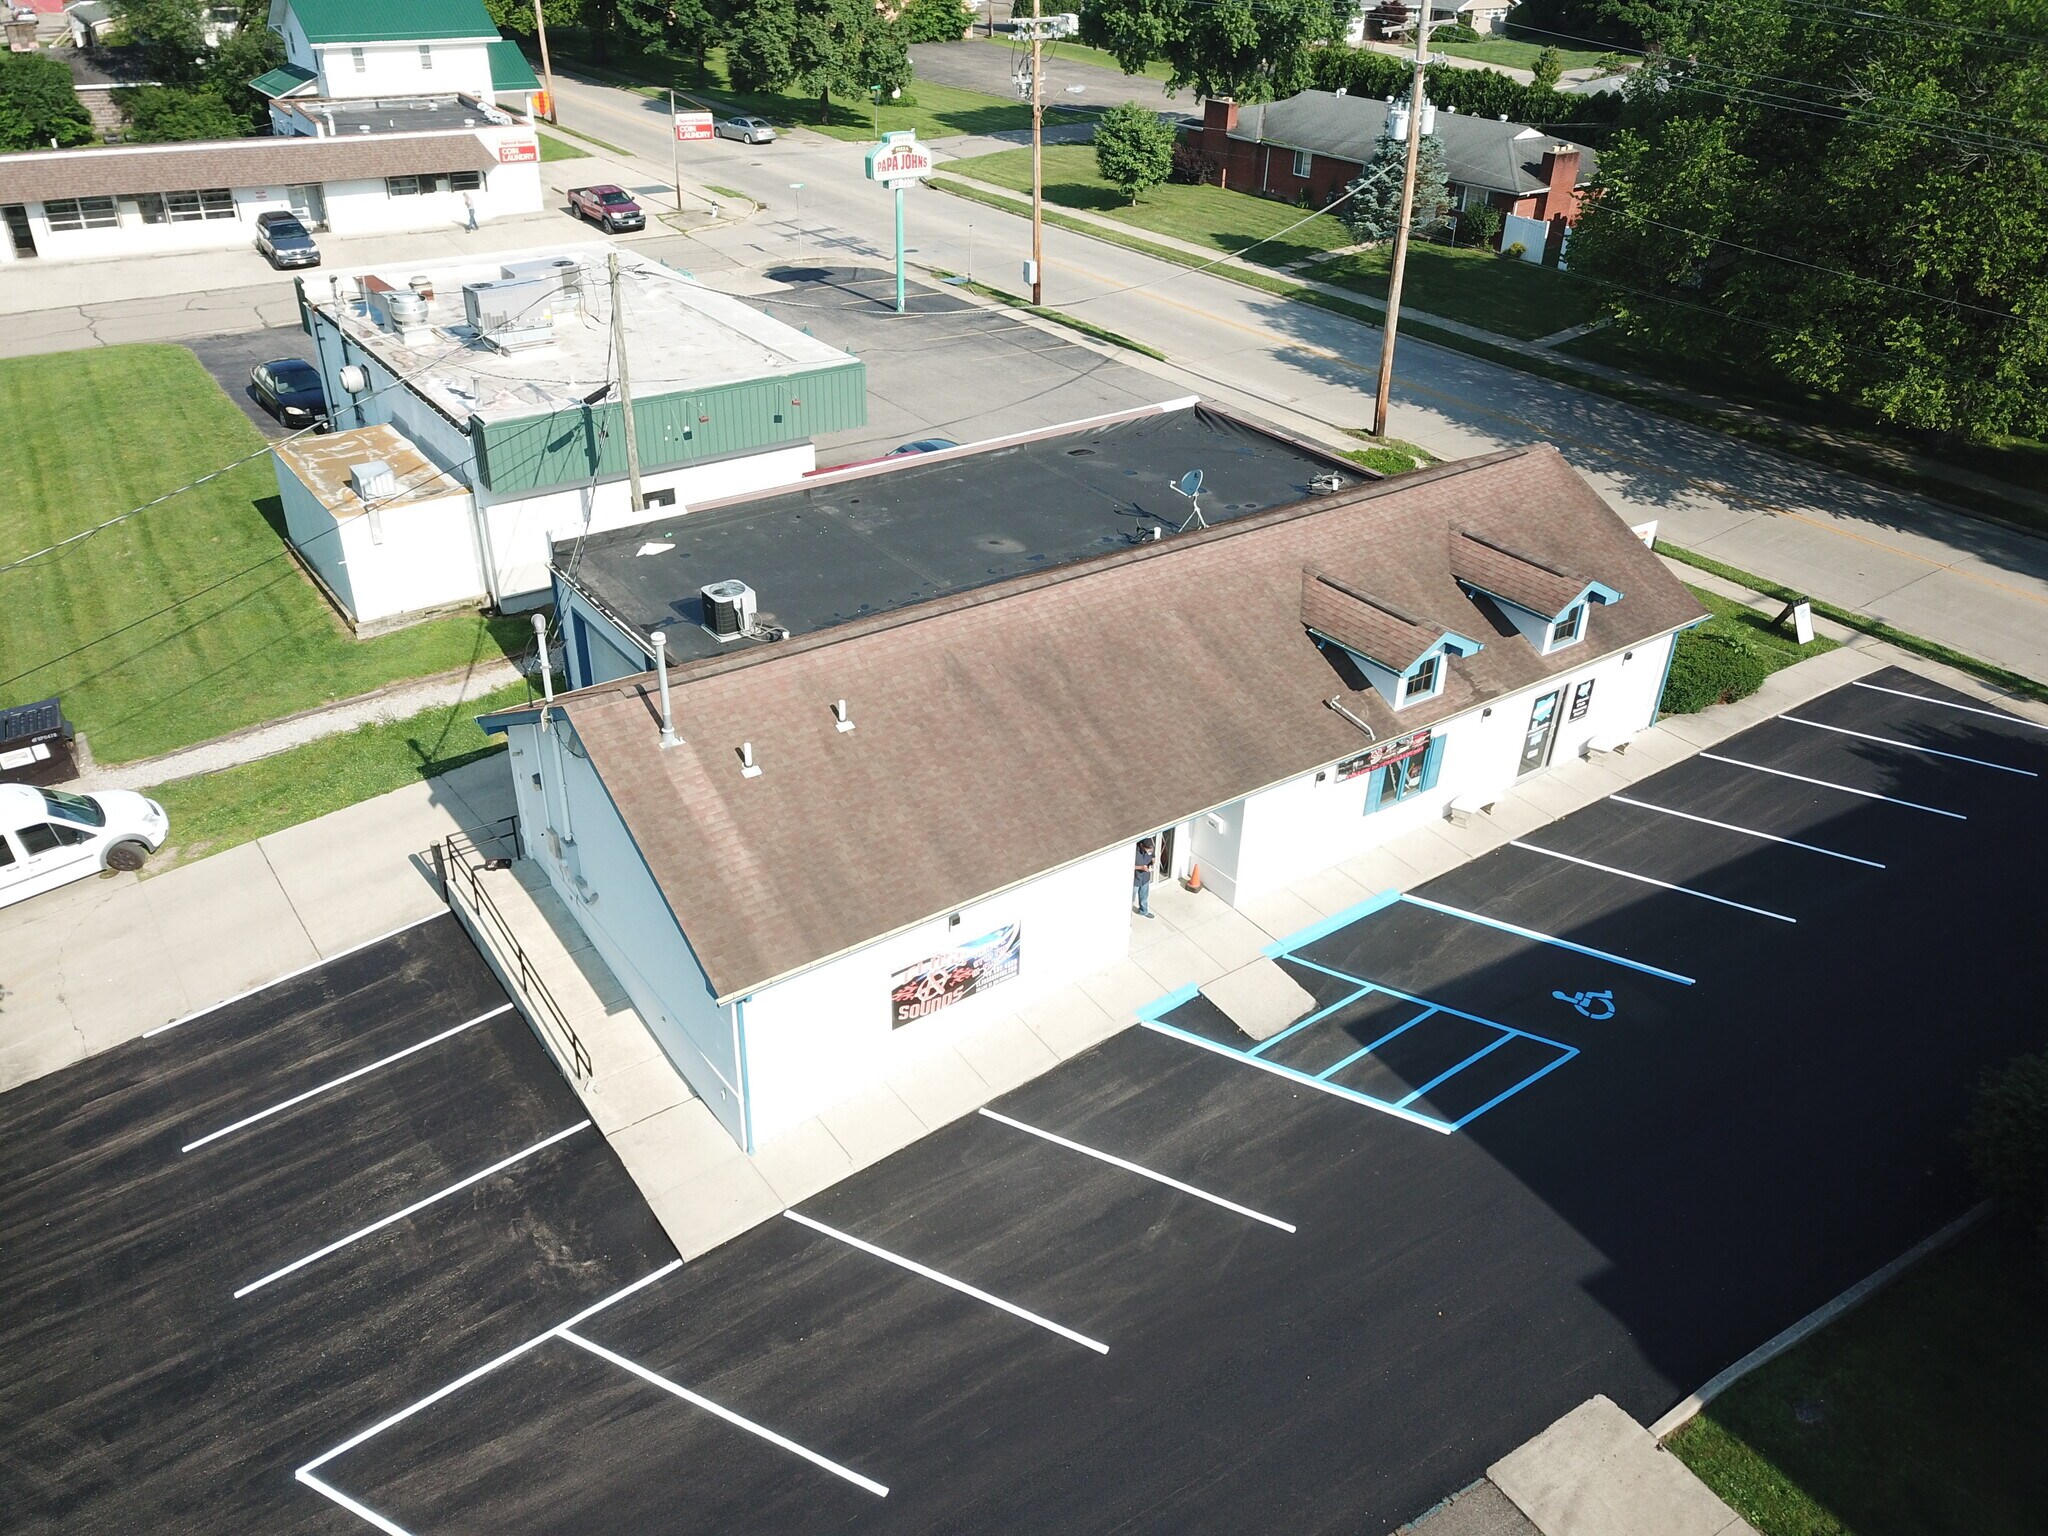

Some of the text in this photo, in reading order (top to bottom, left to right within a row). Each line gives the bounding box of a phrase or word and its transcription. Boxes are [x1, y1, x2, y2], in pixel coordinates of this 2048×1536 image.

[502, 153, 534, 161] LAUNDRY
[878, 154, 928, 172] PAPA JOHNS
[898, 985, 964, 1020] SOUNDS
